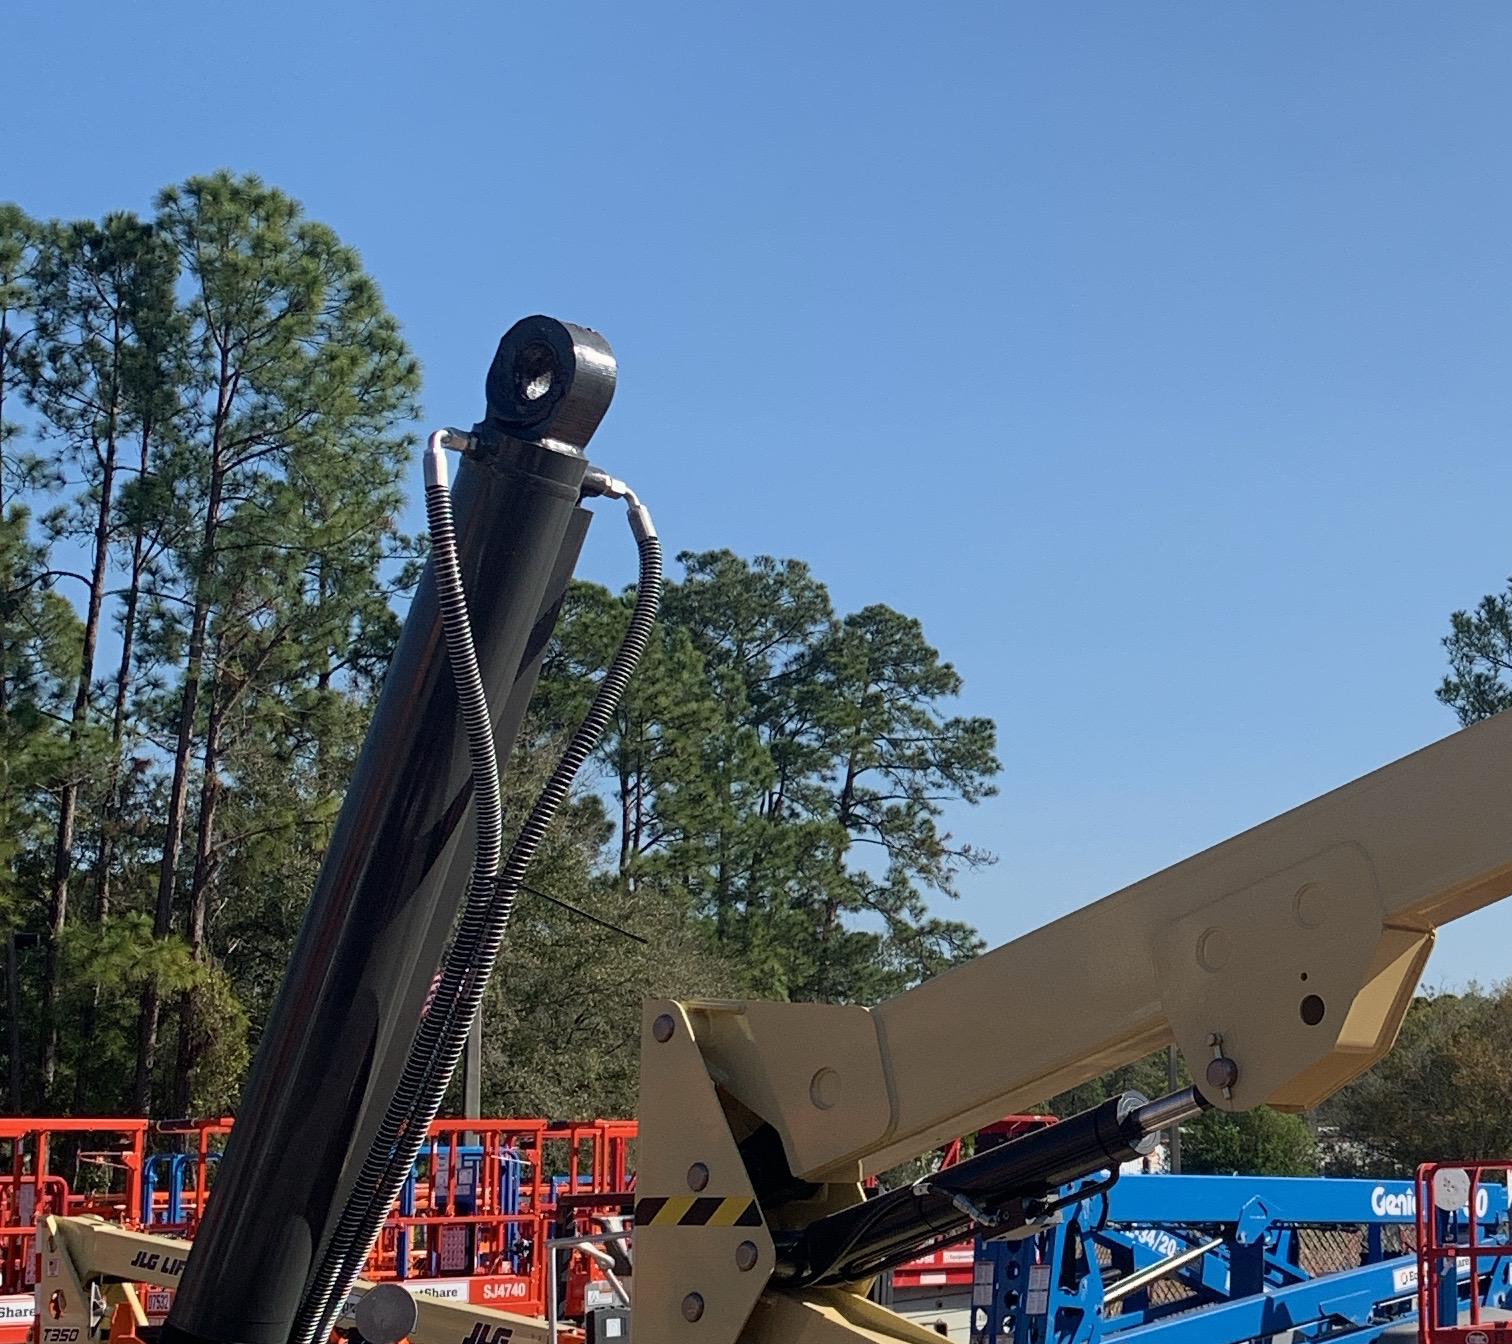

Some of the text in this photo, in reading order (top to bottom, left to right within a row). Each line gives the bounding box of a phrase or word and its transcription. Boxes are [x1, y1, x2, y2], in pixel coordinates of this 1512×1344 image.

[1371, 1185, 1417, 1217] Geni
[130, 1250, 187, 1276] JLG LIF
[483, 1282, 526, 1300] SJ4740
[43, 1328, 80, 1343] T350
